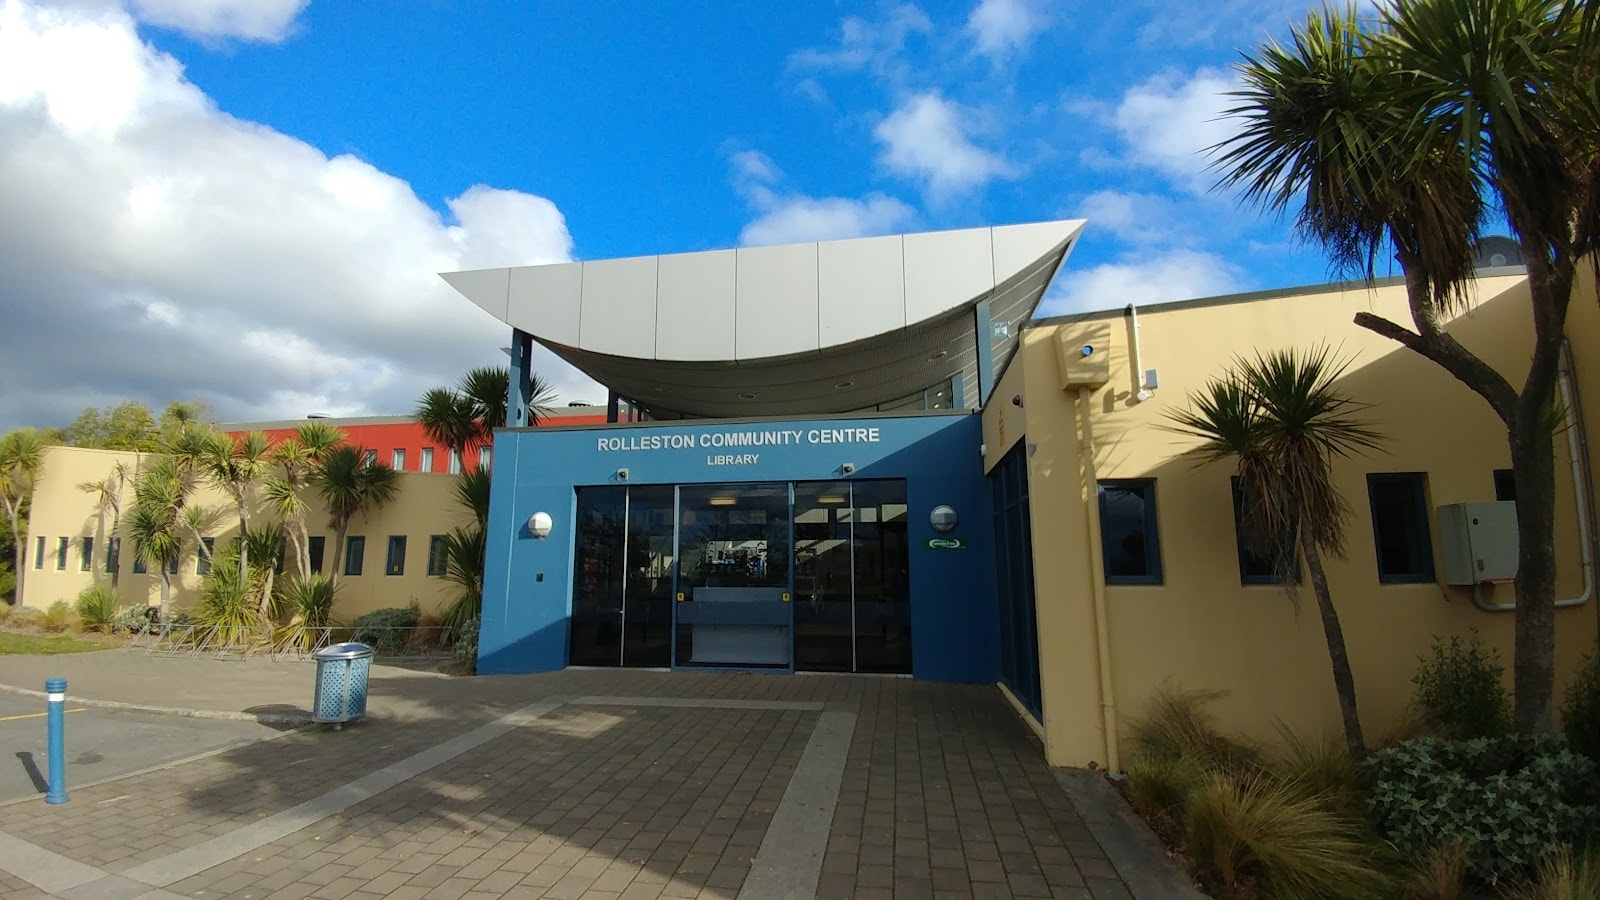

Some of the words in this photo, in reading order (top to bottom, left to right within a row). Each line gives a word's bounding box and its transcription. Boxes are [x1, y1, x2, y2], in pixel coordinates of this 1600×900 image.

[597, 434, 695, 451] ROLLESTON
[699, 429, 803, 448] COMMUNITY
[807, 427, 880, 444] CENTRE
[707, 454, 760, 466] LIBRARY
